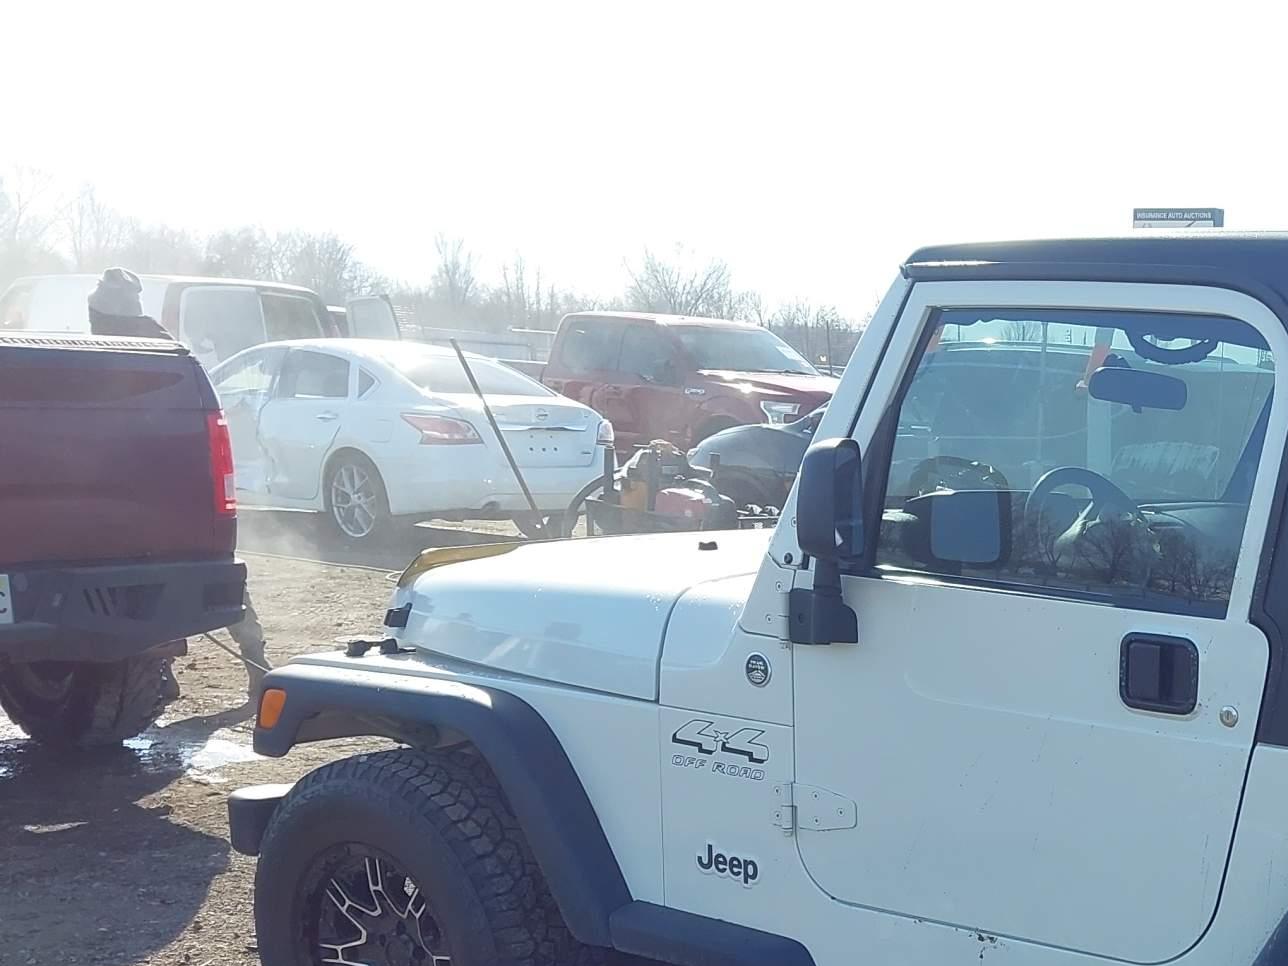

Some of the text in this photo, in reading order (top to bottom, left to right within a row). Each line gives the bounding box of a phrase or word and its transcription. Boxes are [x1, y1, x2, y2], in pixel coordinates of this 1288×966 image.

[671, 754, 765, 781] OFF ROAD
[697, 843, 759, 884] Jeep
